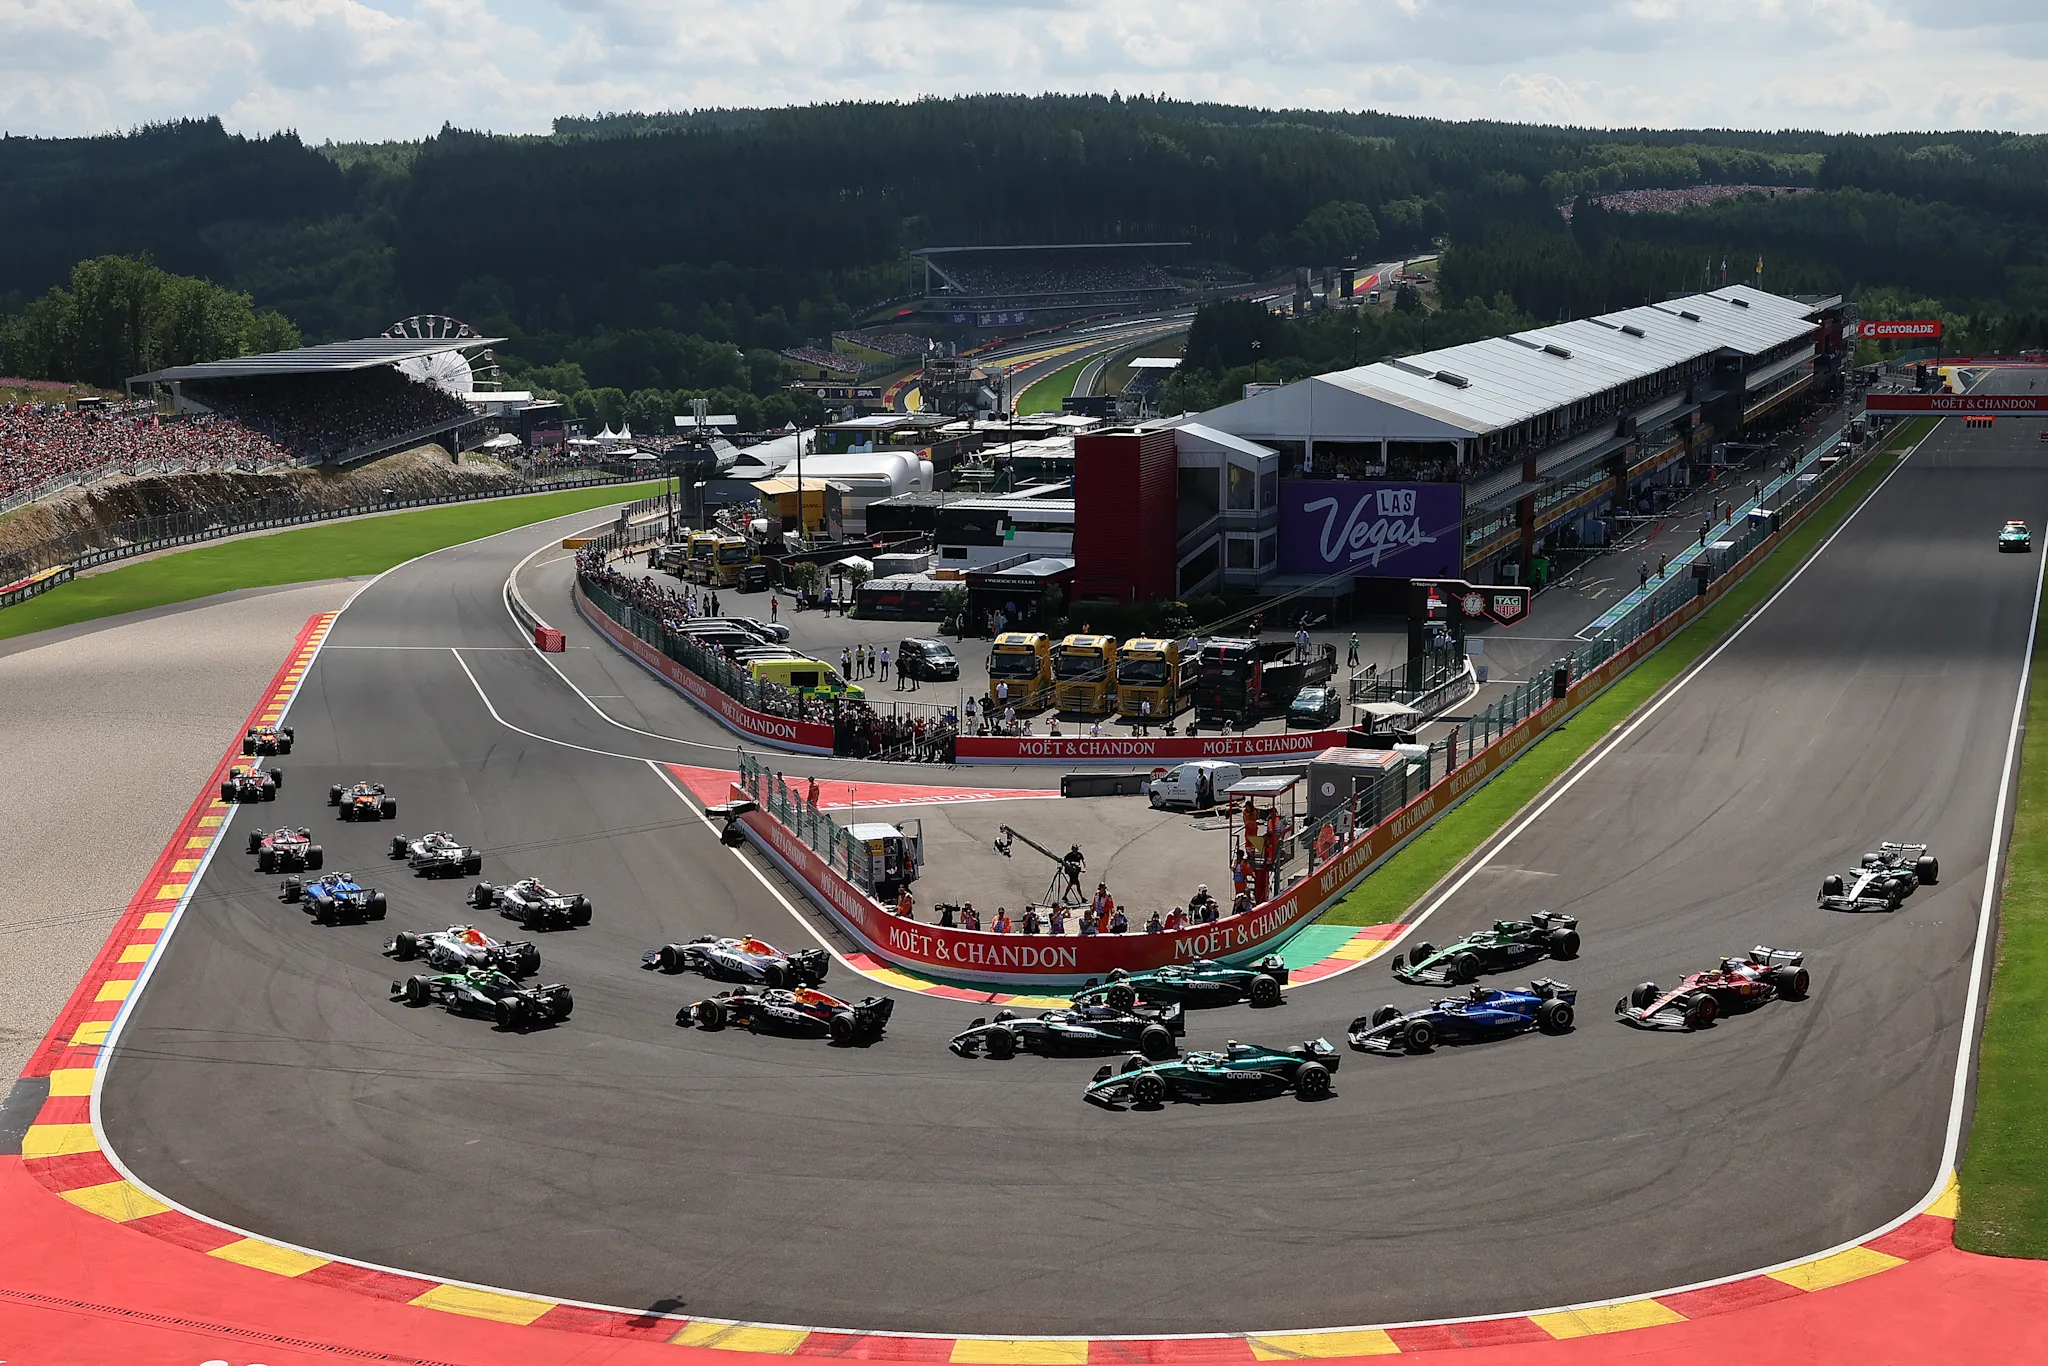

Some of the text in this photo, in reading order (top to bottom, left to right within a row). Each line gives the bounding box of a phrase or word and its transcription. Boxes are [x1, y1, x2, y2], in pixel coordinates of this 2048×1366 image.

[1877, 325, 1934, 334] GATORADE
[1931, 397, 2037, 409] MOËT & CHANDON
[1381, 492, 1412, 513] LAS
[1303, 493, 1437, 568] Vegas
[1496, 597, 1519, 605] TAG
[1495, 606, 1519, 617] HEUER
[739, 713, 797, 740] CHANDON
[1018, 739, 1156, 755] MOËT & CHANDON
[1202, 735, 1314, 755] MOËT & CHANDON
[1320, 865, 1339, 896] MOËT
[1344, 840, 1373, 878] CHANDON
[1174, 896, 1298, 960] MOËT & CHANDON
[889, 925, 1077, 968] MOËT & CHANDON
[720, 955, 743, 971] VISA
[763, 1007, 800, 1020] ORACLE
[1061, 1031, 1097, 1039] PETRONAS
[1226, 1072, 1262, 1080] aramco
